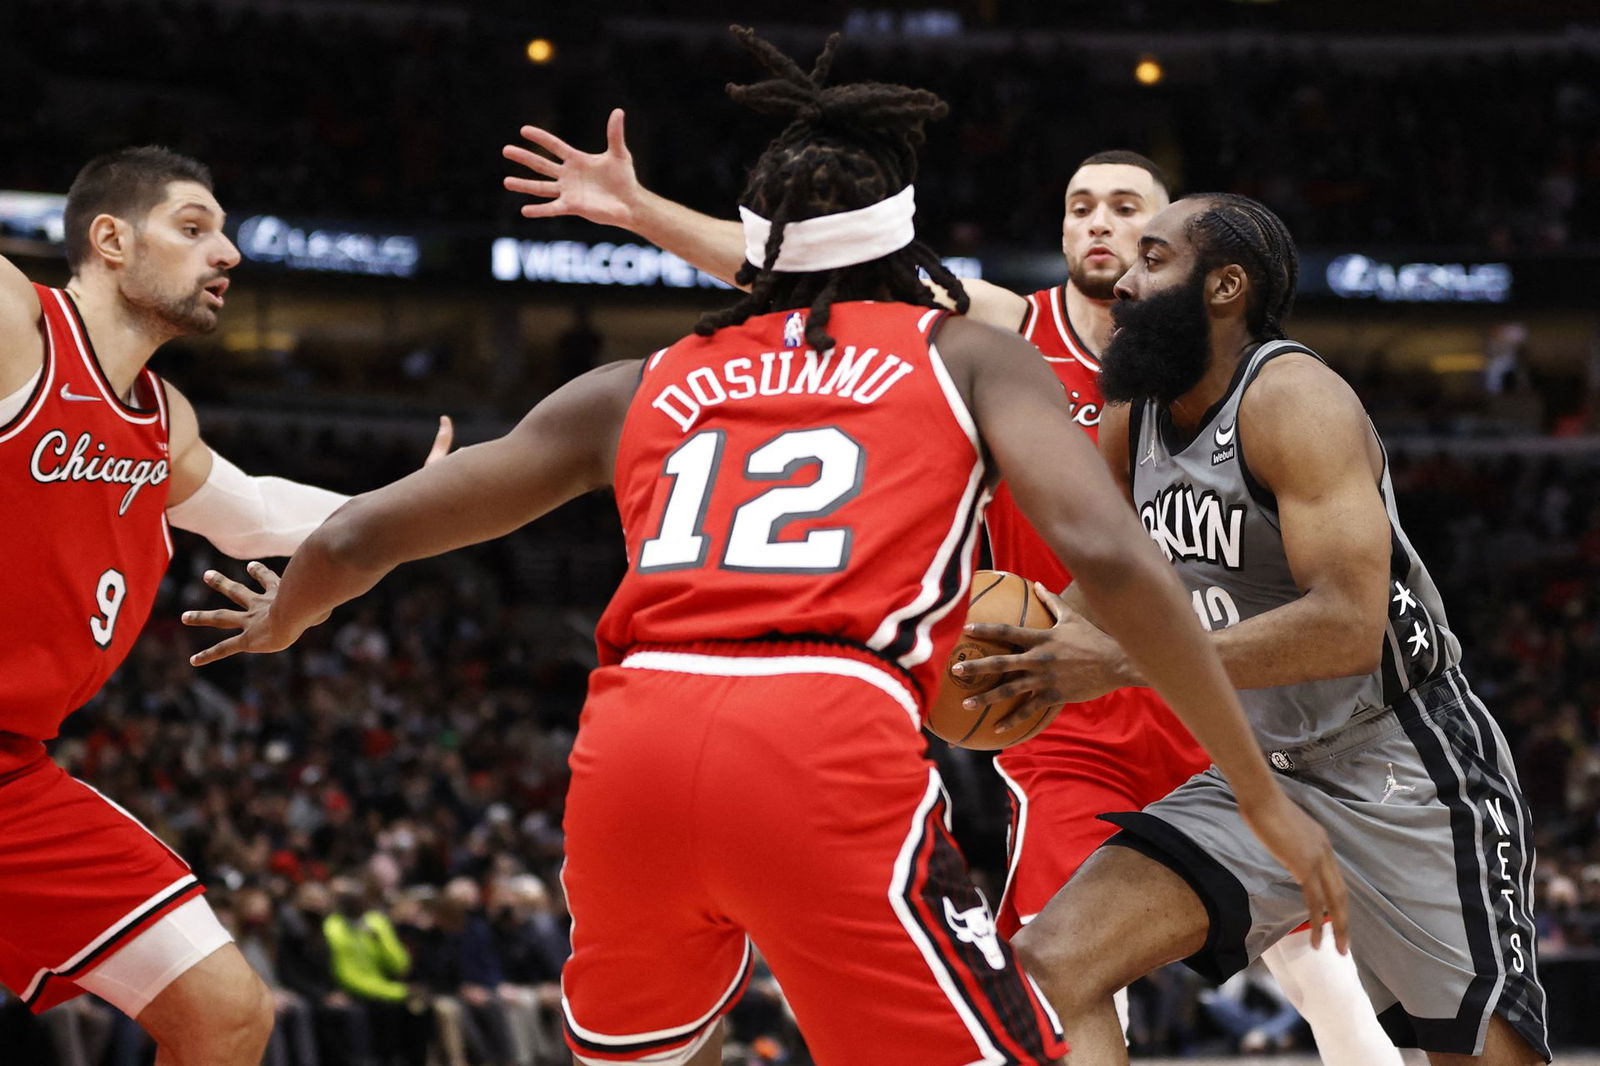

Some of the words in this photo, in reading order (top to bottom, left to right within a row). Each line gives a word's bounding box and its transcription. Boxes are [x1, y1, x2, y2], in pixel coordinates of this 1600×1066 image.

[652, 346, 914, 433] DOSUNMU
[30, 429, 169, 517] Chicago
[1212, 446, 1234, 465] Webull
[638, 425, 866, 575] 12
[90, 567, 127, 650] 9
[1485, 798, 1524, 973] NETS
